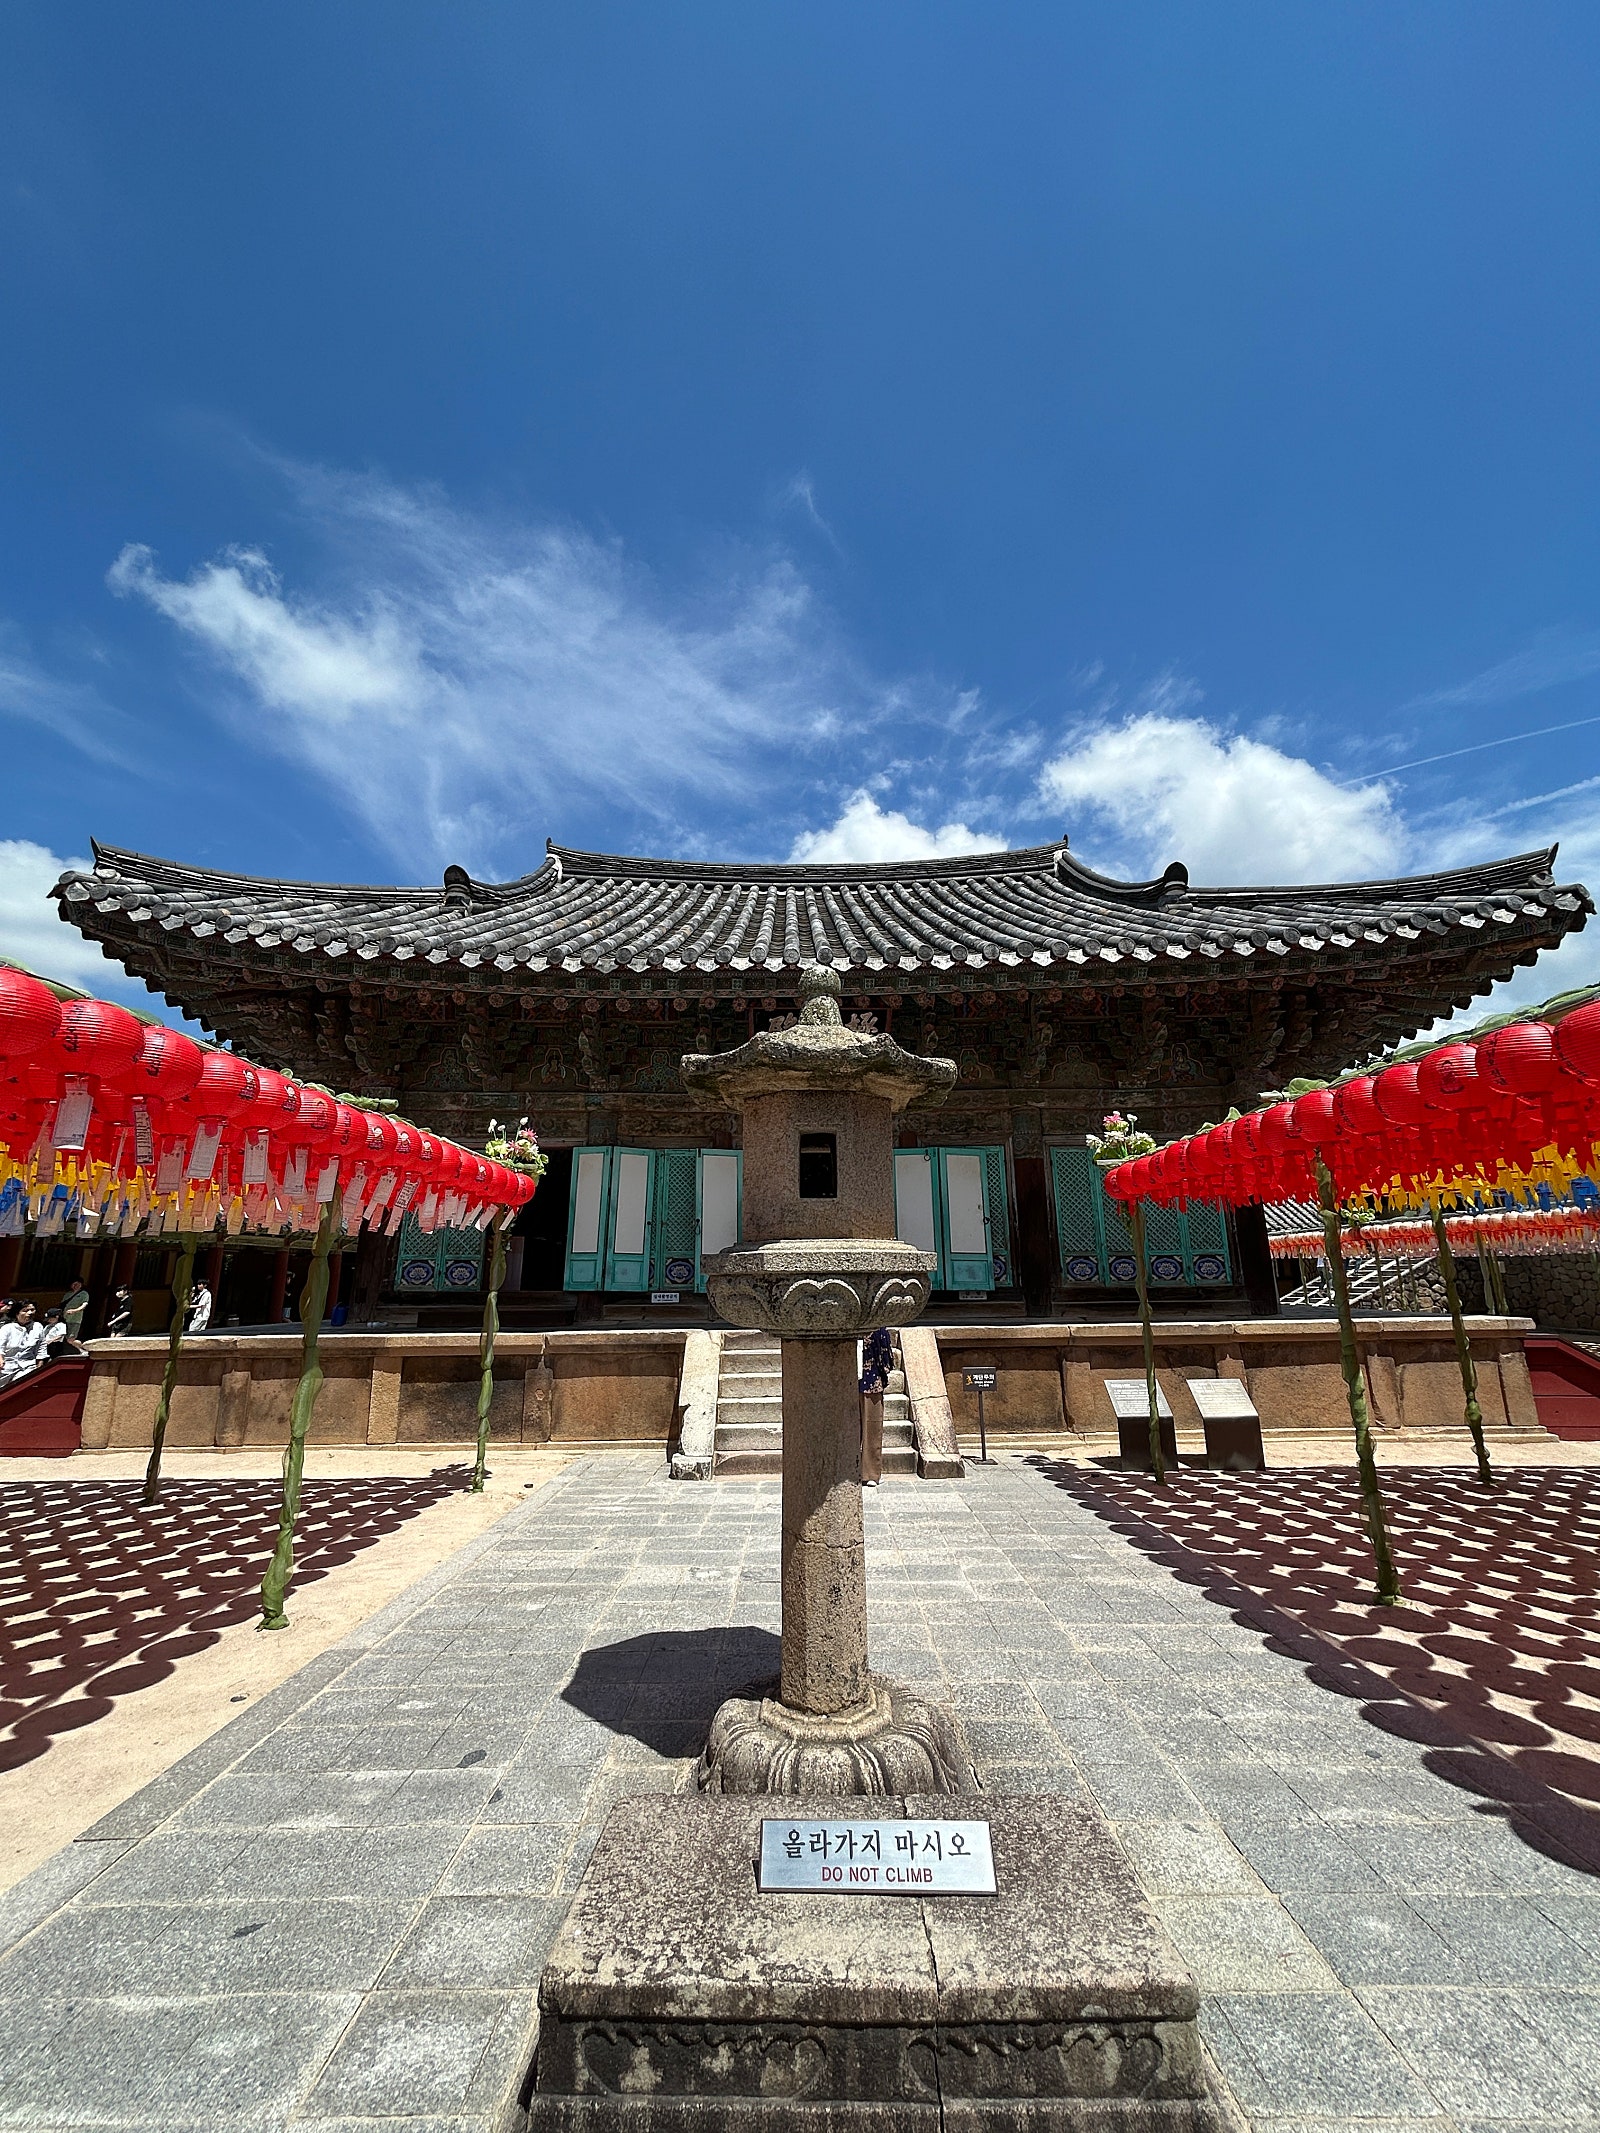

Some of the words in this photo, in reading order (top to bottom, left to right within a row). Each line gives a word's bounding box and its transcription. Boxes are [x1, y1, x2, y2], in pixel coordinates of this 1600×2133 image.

[782, 1828, 881, 1861] 올라가지
[894, 1829, 972, 1861] 마시오
[821, 1866, 843, 1882] DO
[848, 1866, 880, 1883] NOT
[885, 1866, 933, 1883] CLIMB
